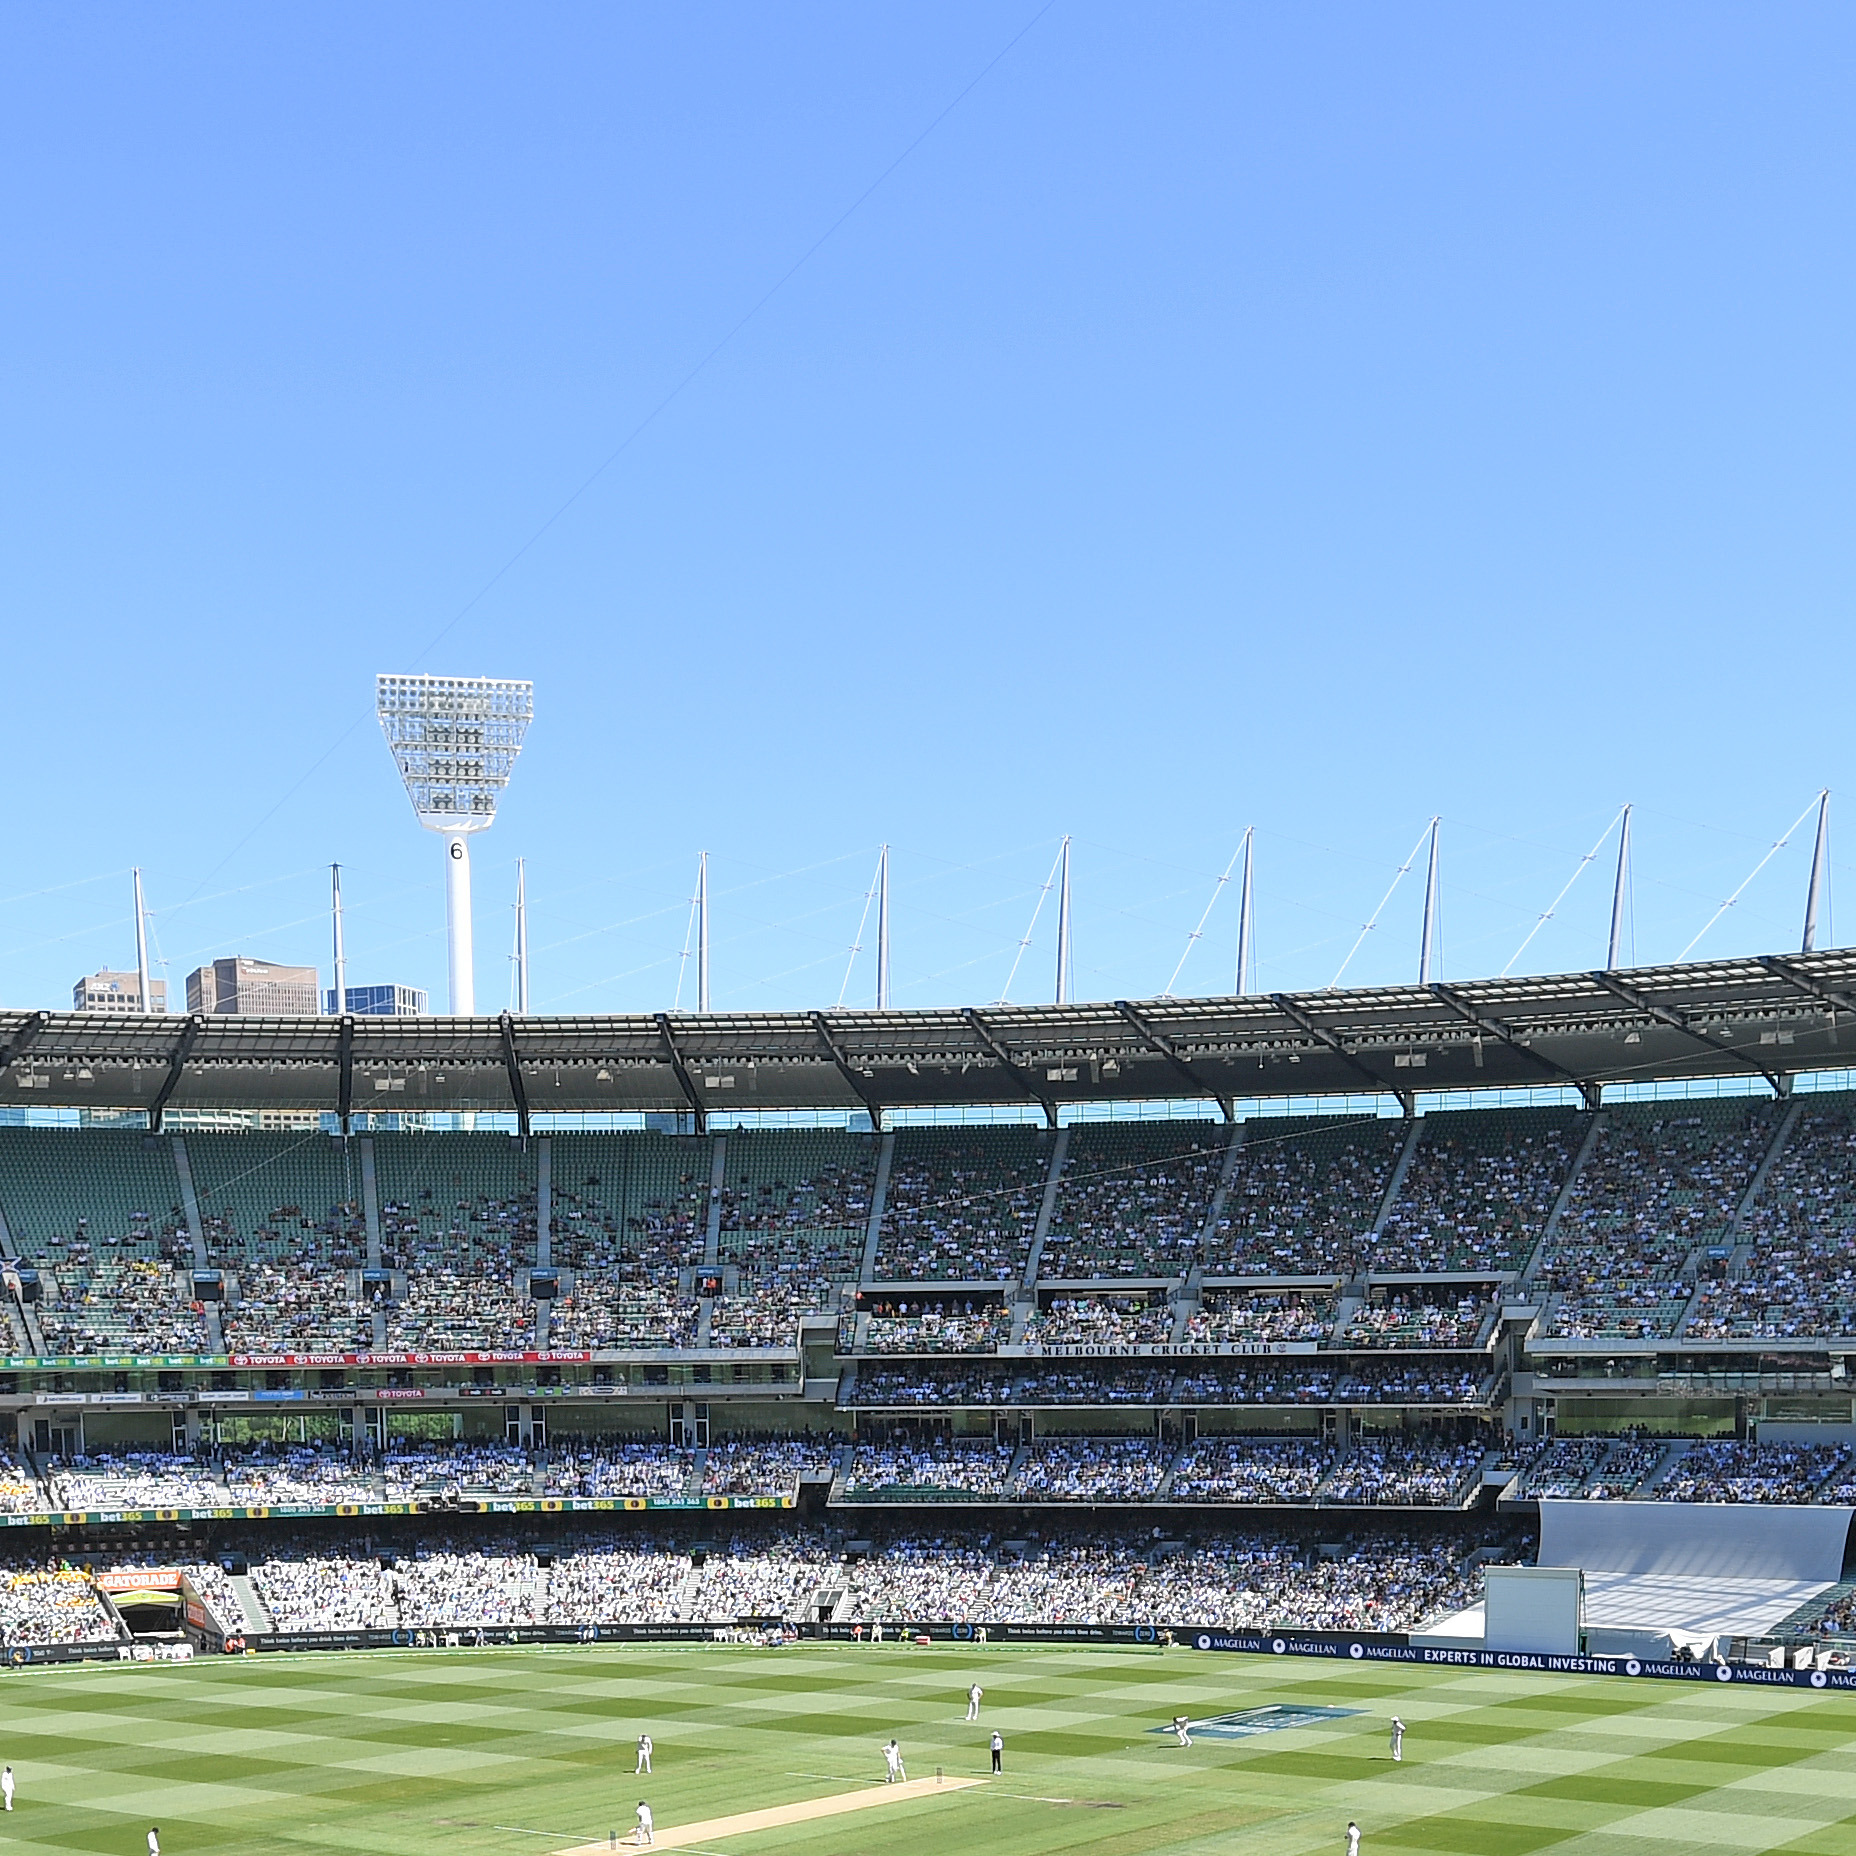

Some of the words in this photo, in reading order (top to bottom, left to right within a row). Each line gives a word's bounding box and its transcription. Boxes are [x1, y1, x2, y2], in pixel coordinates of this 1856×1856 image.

[450, 843, 463, 860] 6
[552, 1351, 583, 1360] TOYOTA
[1042, 1344, 1141, 1356] MELBOURNE
[1152, 1344, 1220, 1355] CRICKET
[1231, 1343, 1271, 1354] CLUB
[250, 1356, 285, 1365] TOYOTA
[309, 1355, 344, 1364] TOYOTA
[372, 1354, 407, 1363] TOYOTA
[430, 1353, 465, 1362] TOYOTA
[492, 1352, 524, 1361] TOYOTA
[392, 1389, 422, 1398] TOYOTA
[8, 1514, 50, 1525] bet365
[101, 1510, 143, 1522] bet365
[192, 1508, 233, 1520] bet365
[104, 1572, 178, 1589] GATORADE
[1214, 1638, 1260, 1650] MAGELLAN
[1289, 1642, 1336, 1655] MAGELLAN
[1367, 1646, 1416, 1659] MAGELLAN
[1425, 1650, 1476, 1664] EXPERTS
[1481, 1653, 1493, 1665] IN
[1498, 1653, 1546, 1669] GLOBAL
[1548, 1656, 1616, 1672] INVESTING
[1645, 1662, 1701, 1678] MAGELLAN
[1736, 1667, 1794, 1682] MAGELLAN
